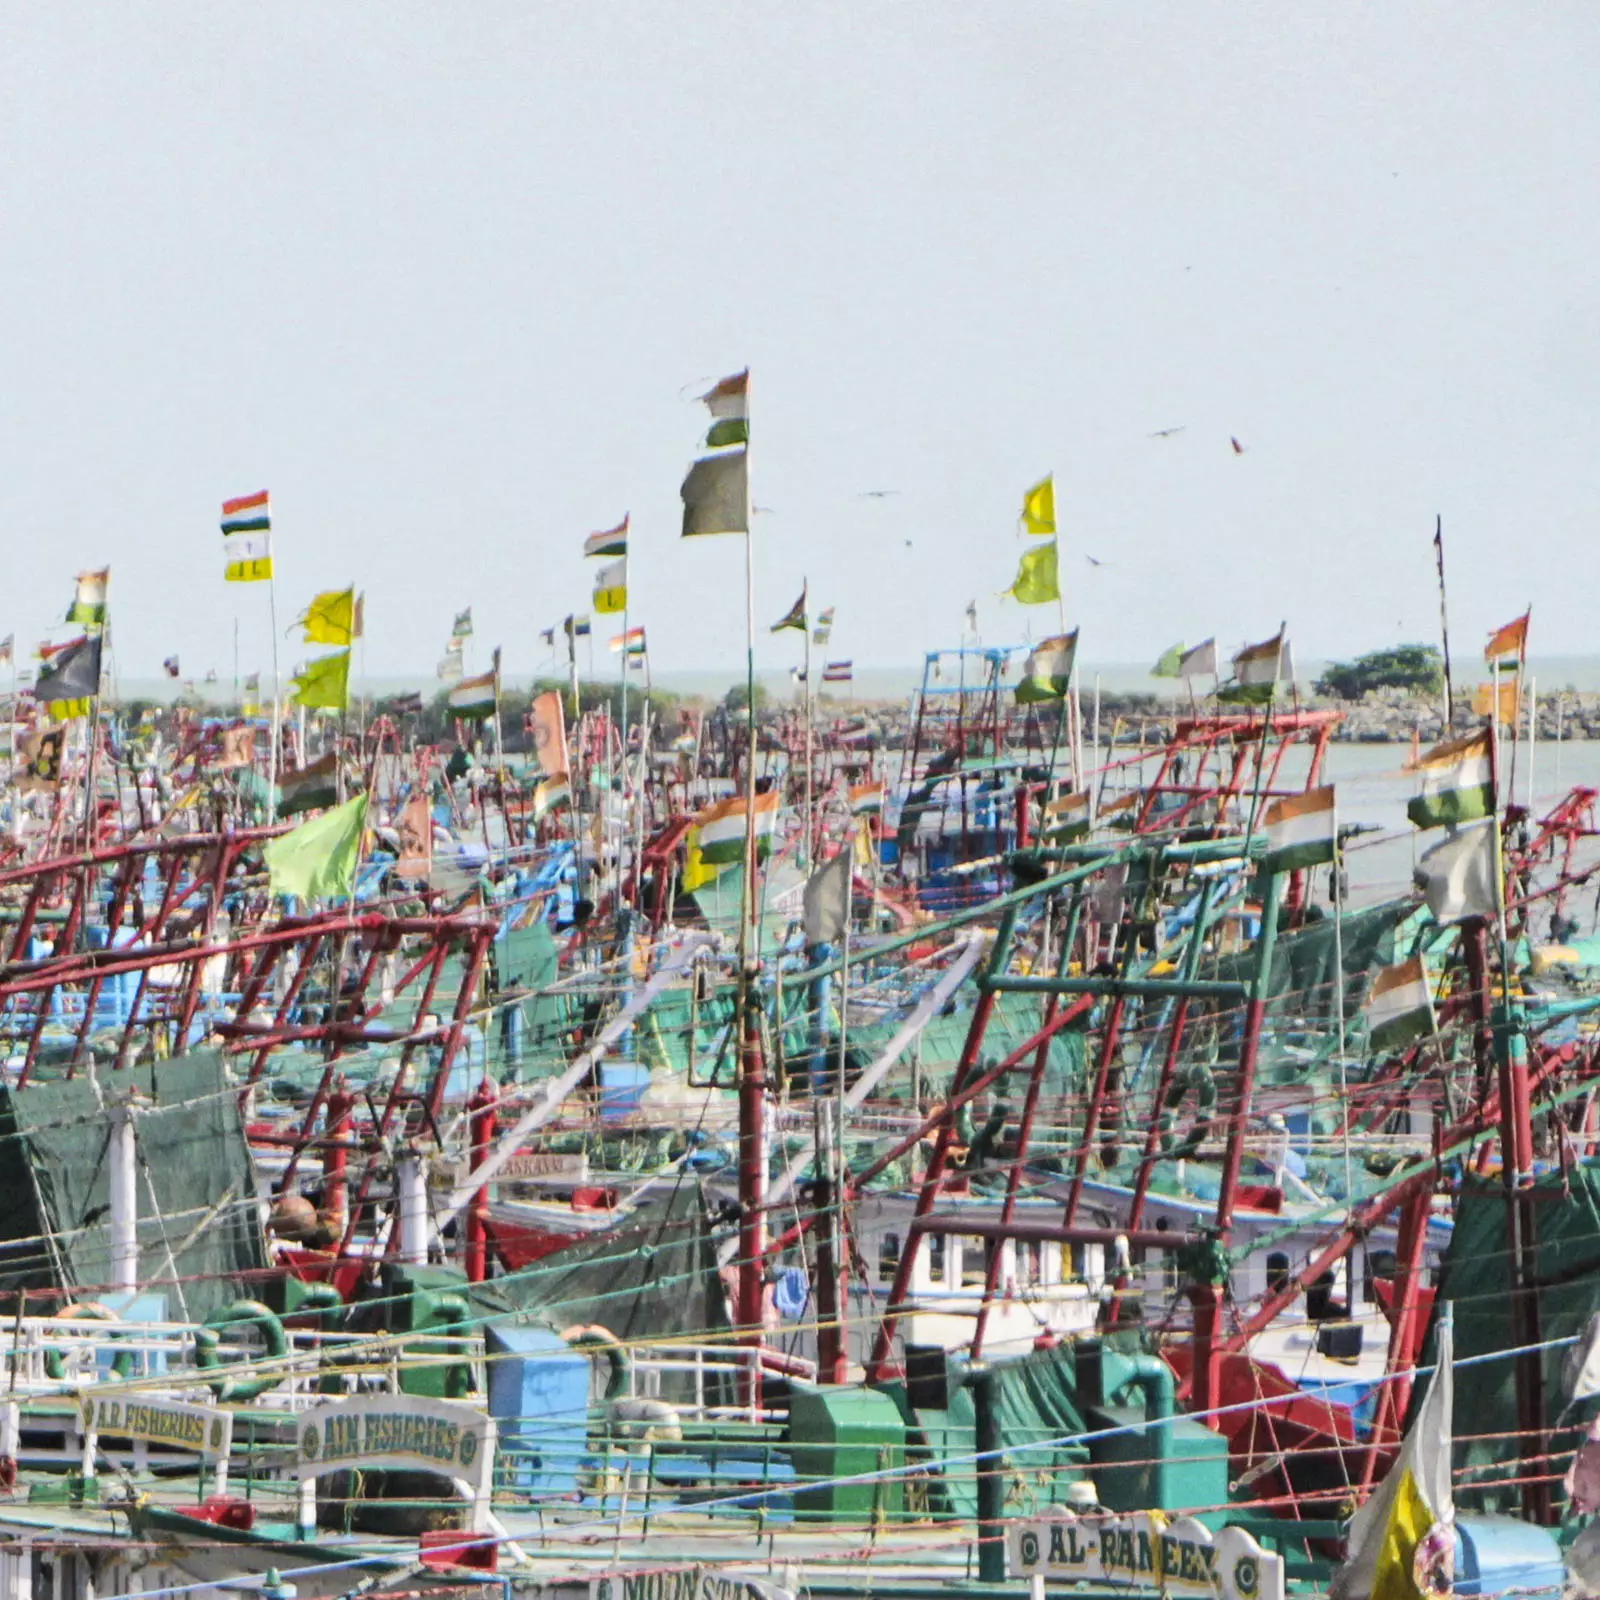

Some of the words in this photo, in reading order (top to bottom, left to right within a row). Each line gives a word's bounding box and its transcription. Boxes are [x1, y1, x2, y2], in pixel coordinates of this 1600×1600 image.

[125, 1403, 205, 1444] FISHERIES
[323, 1414, 359, 1458] AIN
[364, 1412, 458, 1461] FISHERIES
